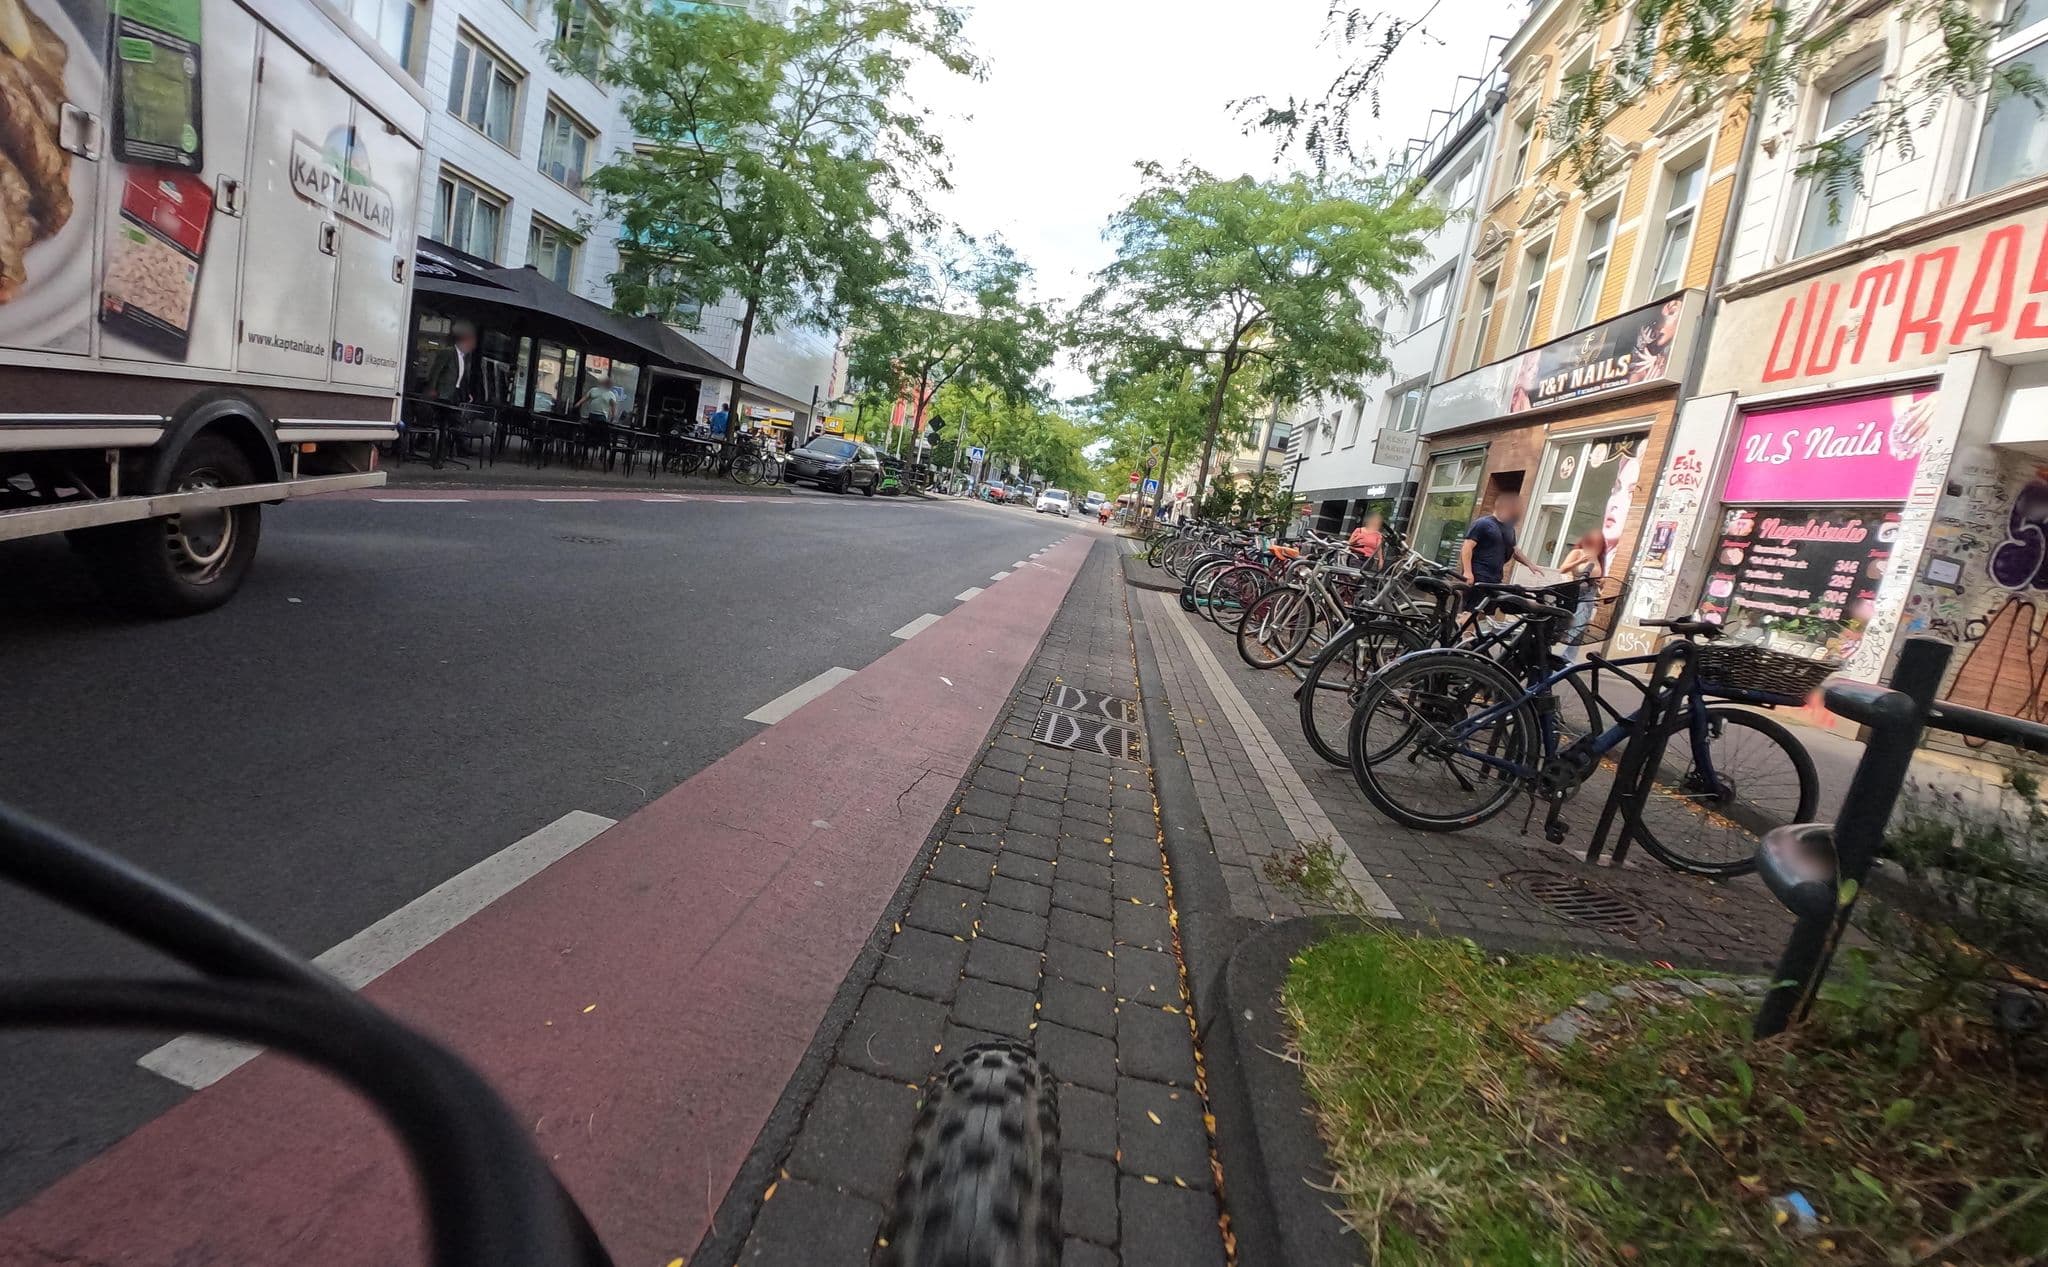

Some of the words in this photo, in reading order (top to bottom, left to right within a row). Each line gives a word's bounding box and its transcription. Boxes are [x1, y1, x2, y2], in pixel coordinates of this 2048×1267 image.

[294, 153, 390, 230] KAPTANLAR
[247, 332, 325, 357] www.kaptanlar.de
[1538, 372, 1569, 398] T&T
[1570, 354, 1632, 390] NAILS
[1802, 420, 1884, 461] Nails
[1669, 473, 1703, 489] CREW
[1758, 518, 1868, 545] Nagelstudio
